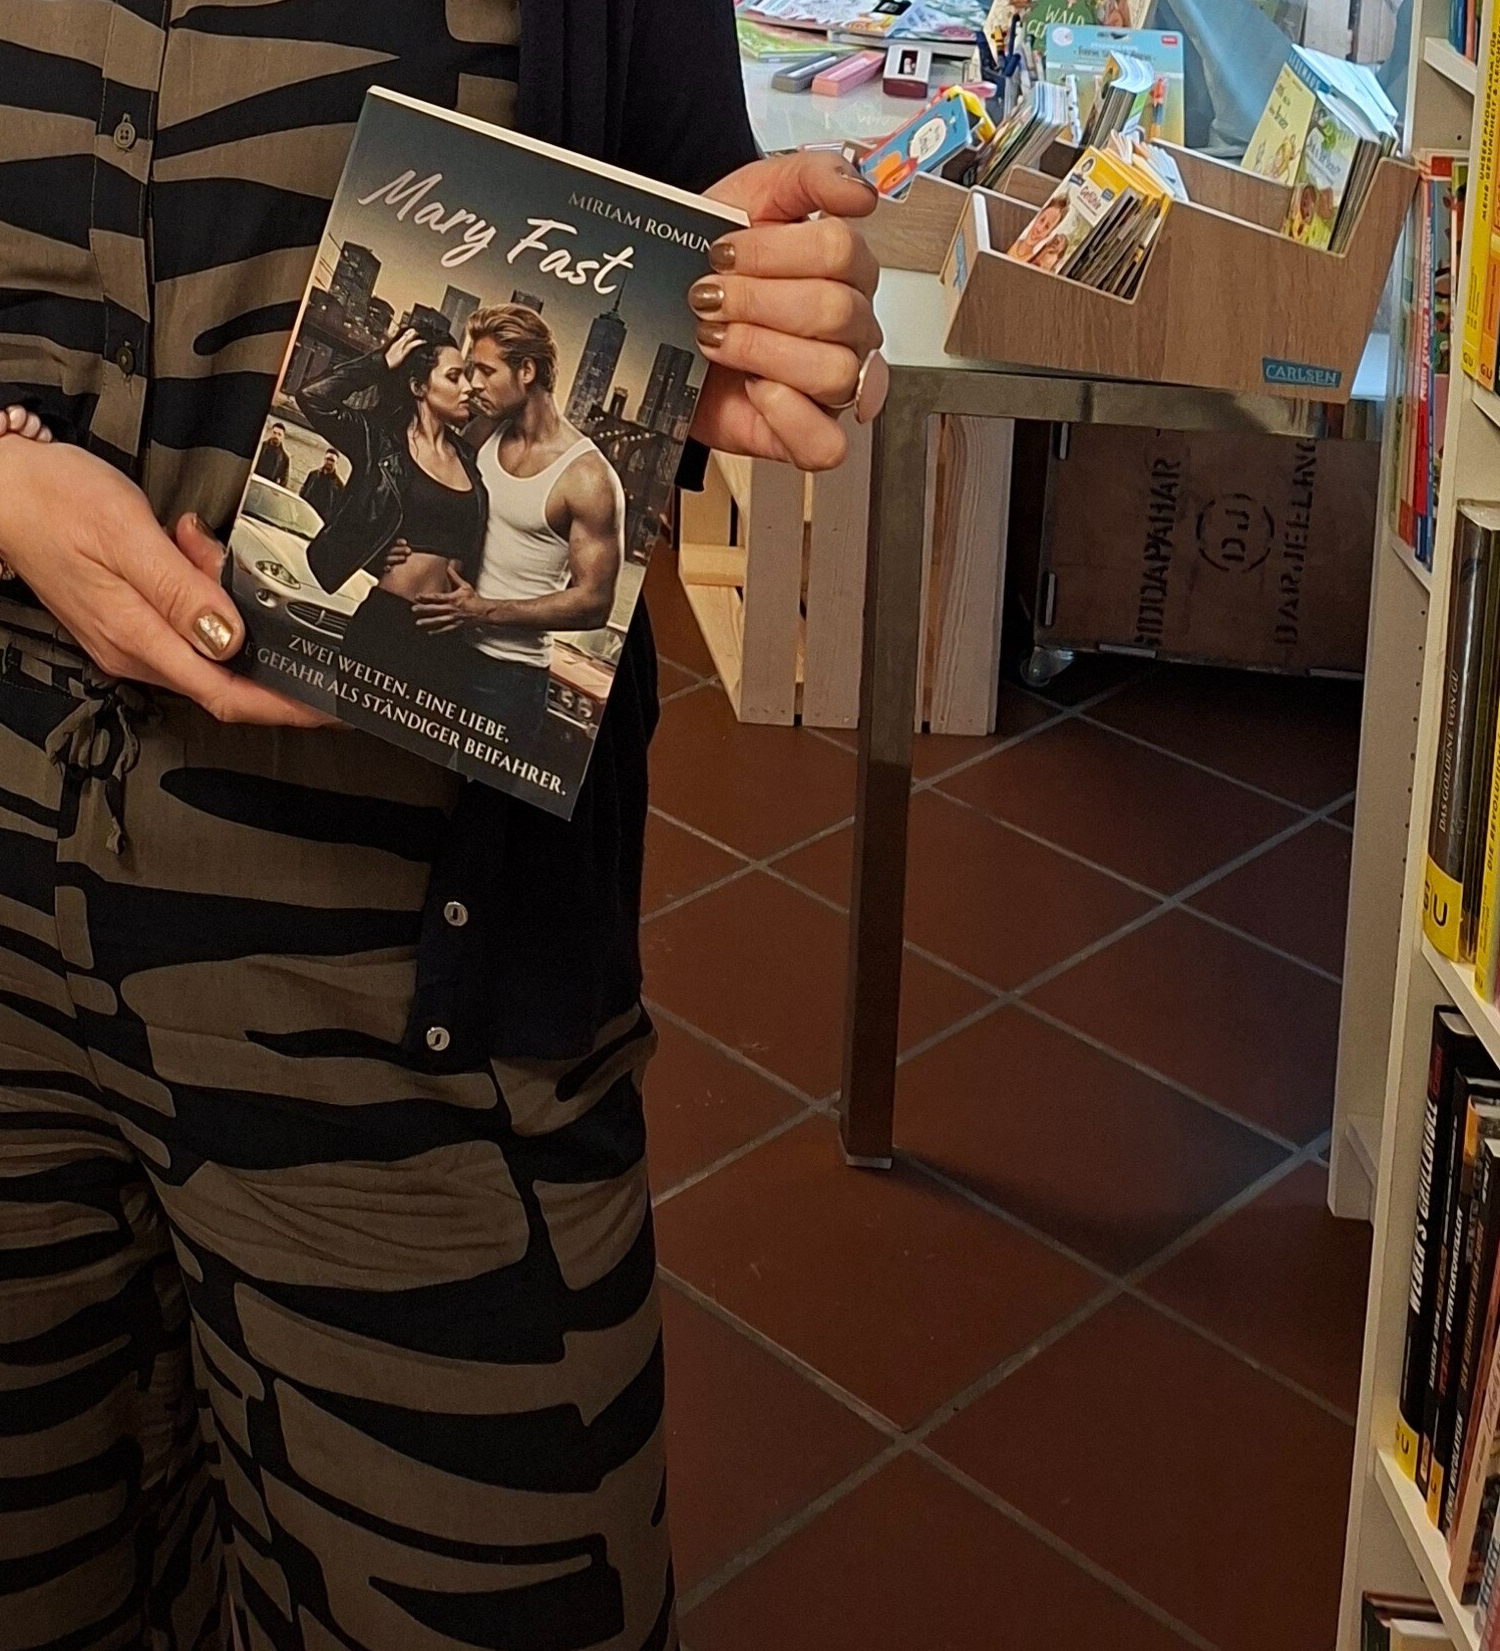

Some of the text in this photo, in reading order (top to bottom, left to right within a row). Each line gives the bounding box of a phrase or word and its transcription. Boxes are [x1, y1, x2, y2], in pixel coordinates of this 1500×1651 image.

[1044, 4, 1085, 25] WALD
[1479, 31, 1497, 181] UNSER PROGRAMM FÜR
[1481, 100, 1497, 221] MEHR GESUNDHEIT
[357, 169, 635, 295] Mary Fast
[568, 191, 642, 230] MIRIAM
[1264, 363, 1339, 385] CARLSEN
[1462, 349, 1474, 368] GU
[1479, 361, 1493, 381] GU
[256, 647, 567, 797] GEFAHR ALS STÄNDIGER BEIFAHRER.
[287, 633, 511, 745] ZWEI WELTEN. EINE LIEBE.
[1438, 668, 1460, 834] DAS GOLDENE VON GU
[1486, 842, 1495, 873] DIE
[1410, 1096, 1438, 1315] WEBER'S GRILLBIBEL
